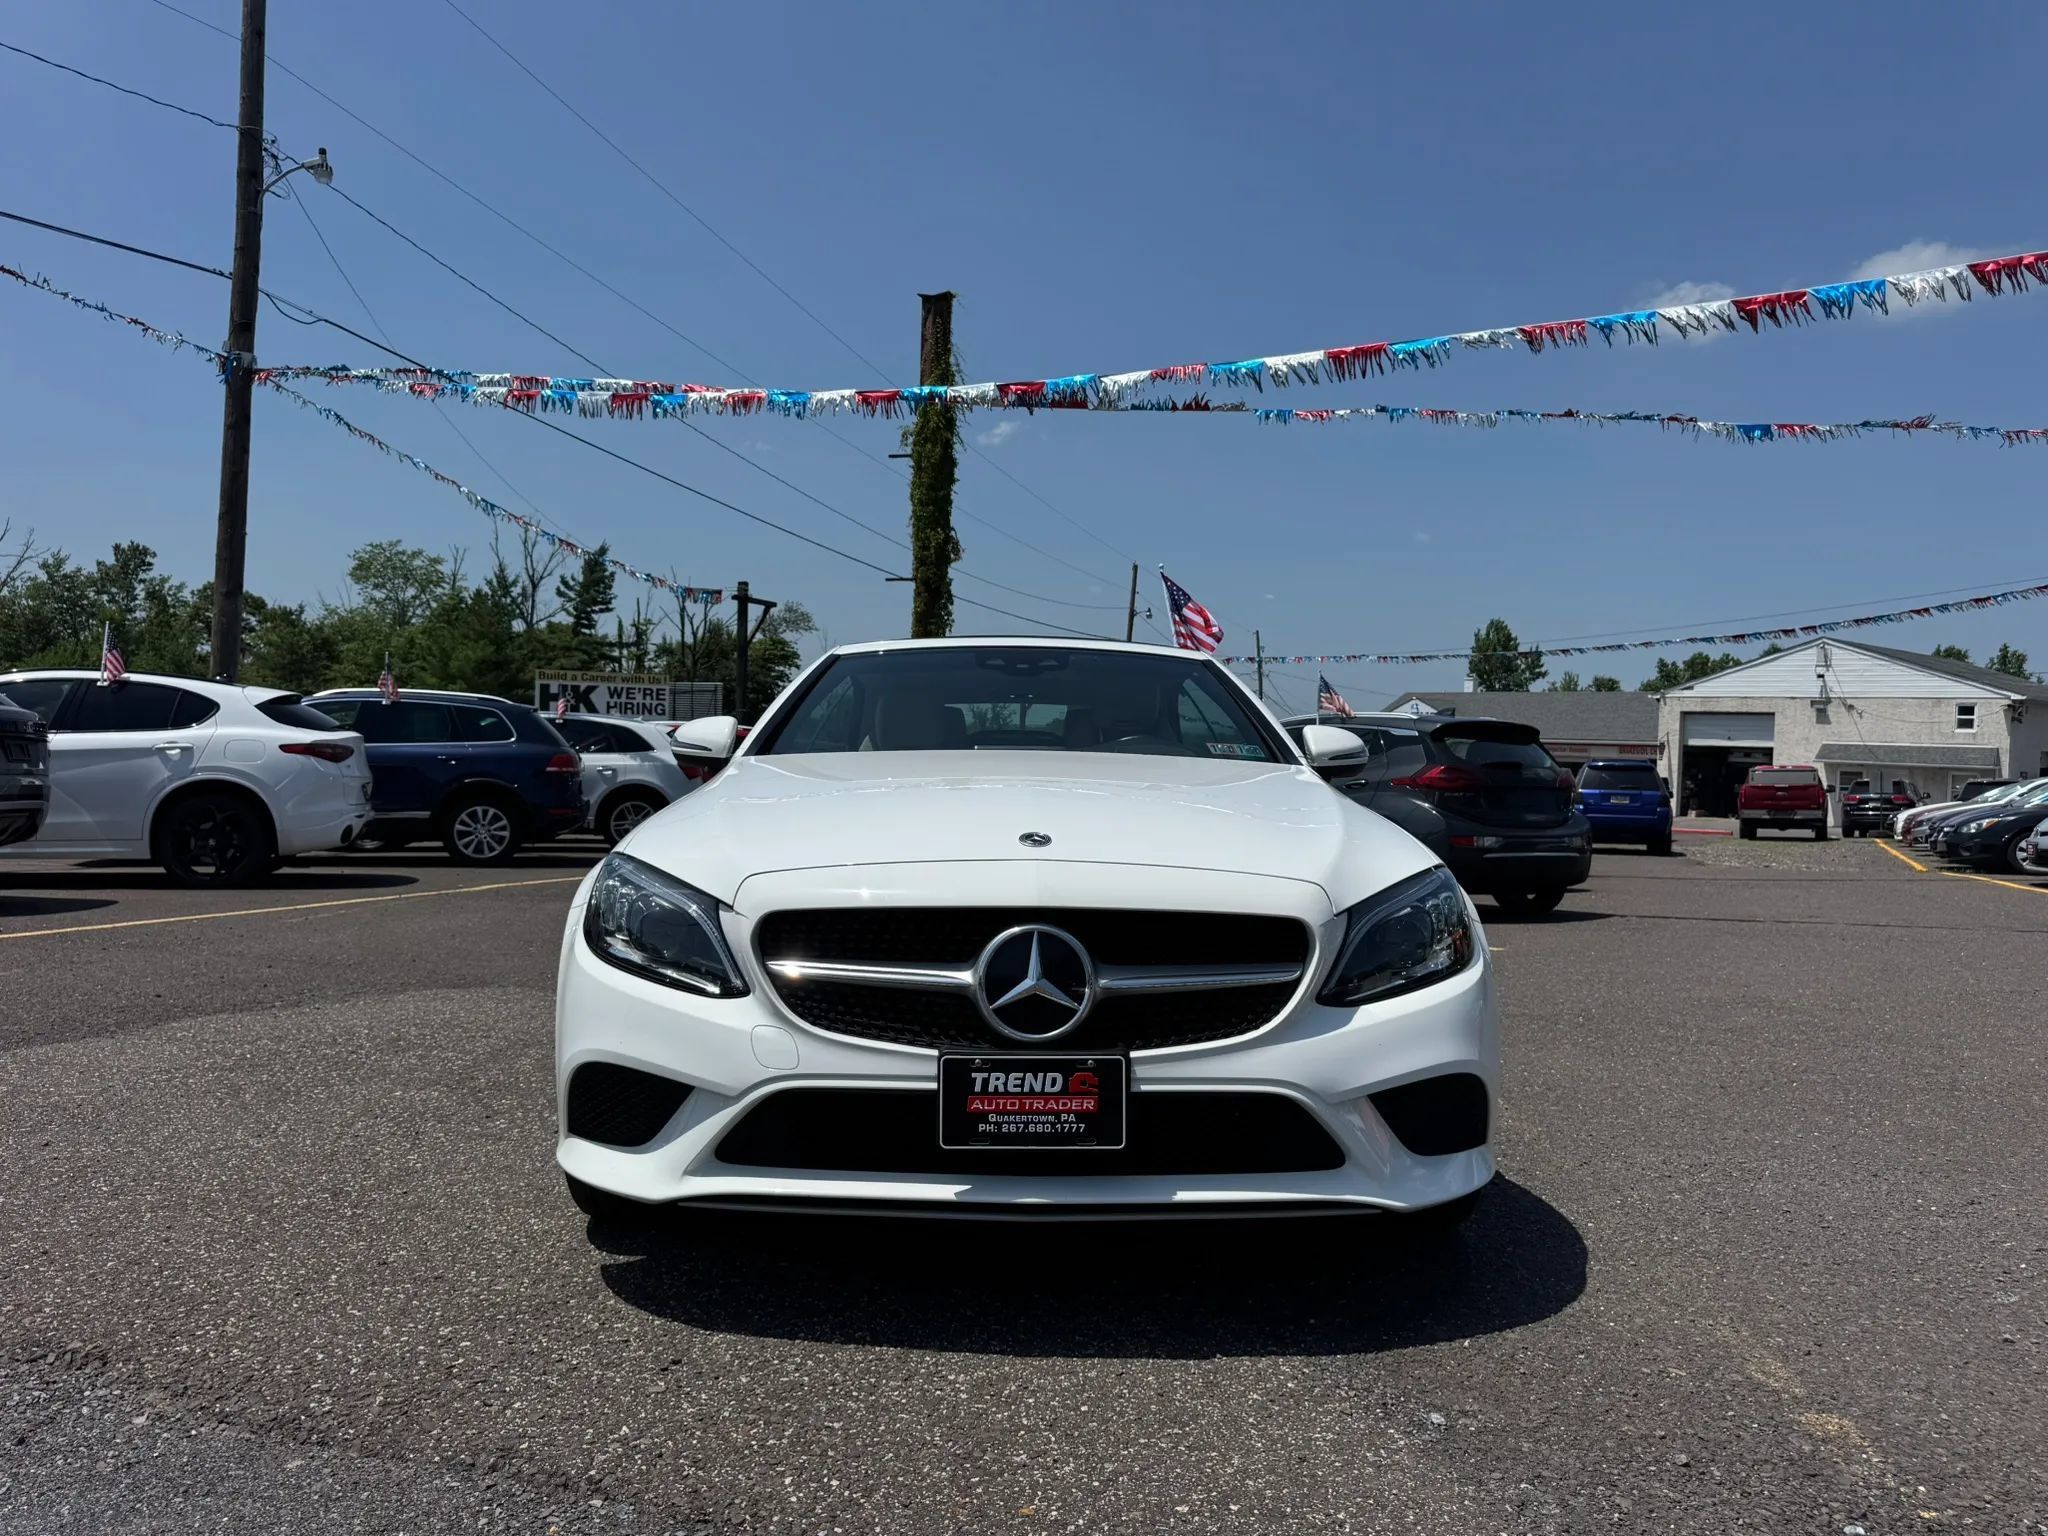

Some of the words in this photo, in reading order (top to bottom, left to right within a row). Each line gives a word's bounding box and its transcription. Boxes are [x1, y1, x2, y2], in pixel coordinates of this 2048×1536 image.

[538, 671, 567, 681] Build
[581, 673, 616, 683] Career
[621, 675, 645, 684] with
[607, 686, 666, 701] WE'RE
[606, 701, 666, 716] HIRING
[971, 1072, 1063, 1093] TREND
[970, 1099, 1019, 1110] AUTO
[1022, 1099, 1094, 1110] TRADER
[1061, 1113, 1076, 1122] PA
[978, 1123, 998, 1133] PH:
[1002, 1123, 1086, 1133] 267.680.1777
